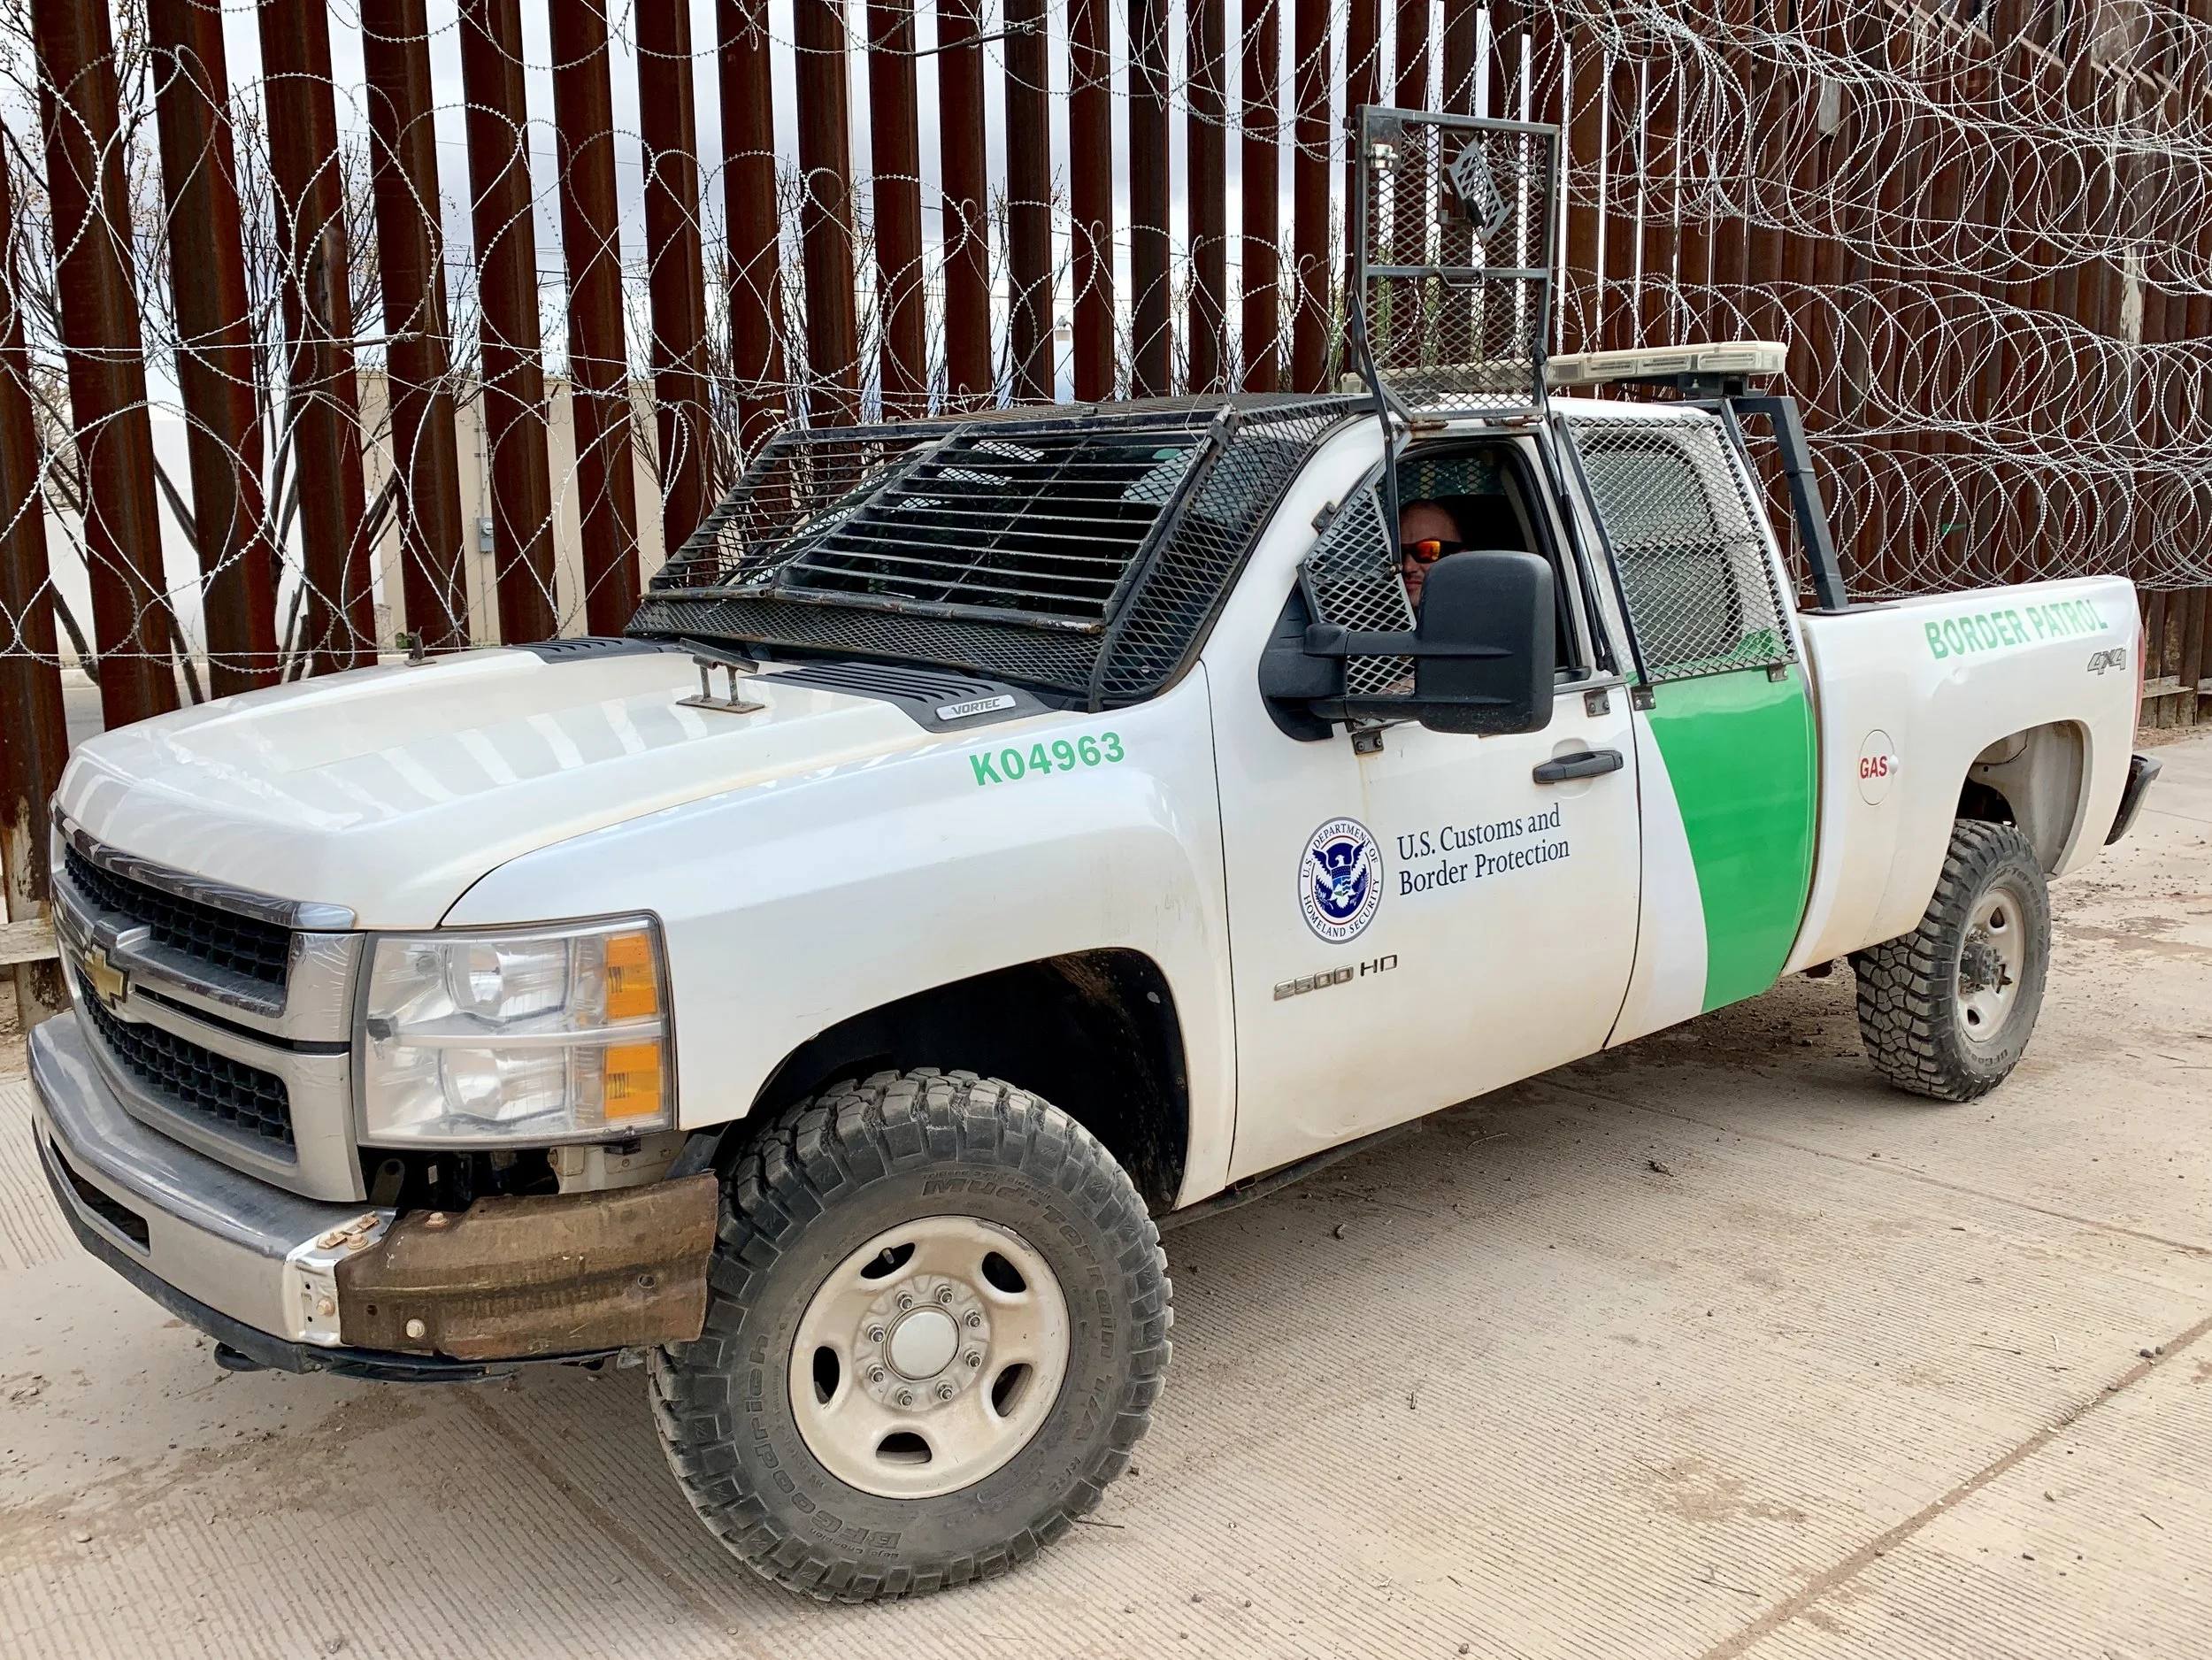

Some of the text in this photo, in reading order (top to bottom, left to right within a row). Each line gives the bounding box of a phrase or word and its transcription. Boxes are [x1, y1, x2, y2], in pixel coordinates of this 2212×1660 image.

[1924, 598, 2108, 660] BORDER PATROL
[951, 697, 1001, 716] VORTEC
[970, 732, 1125, 786] K04963
[1860, 755, 1888, 780] GAS
[1313, 823, 1372, 849] DEPARTMENT
[1369, 848, 1379, 865] OF
[1397, 802, 1561, 860] U.S. Customs and
[1399, 837, 1571, 896] Border Protection
[1303, 879, 1379, 938] HOMELAND SECURITY
[1273, 954, 1398, 1002] 2500 HD
[745, 1334, 902, 1549] BFGoodrich
